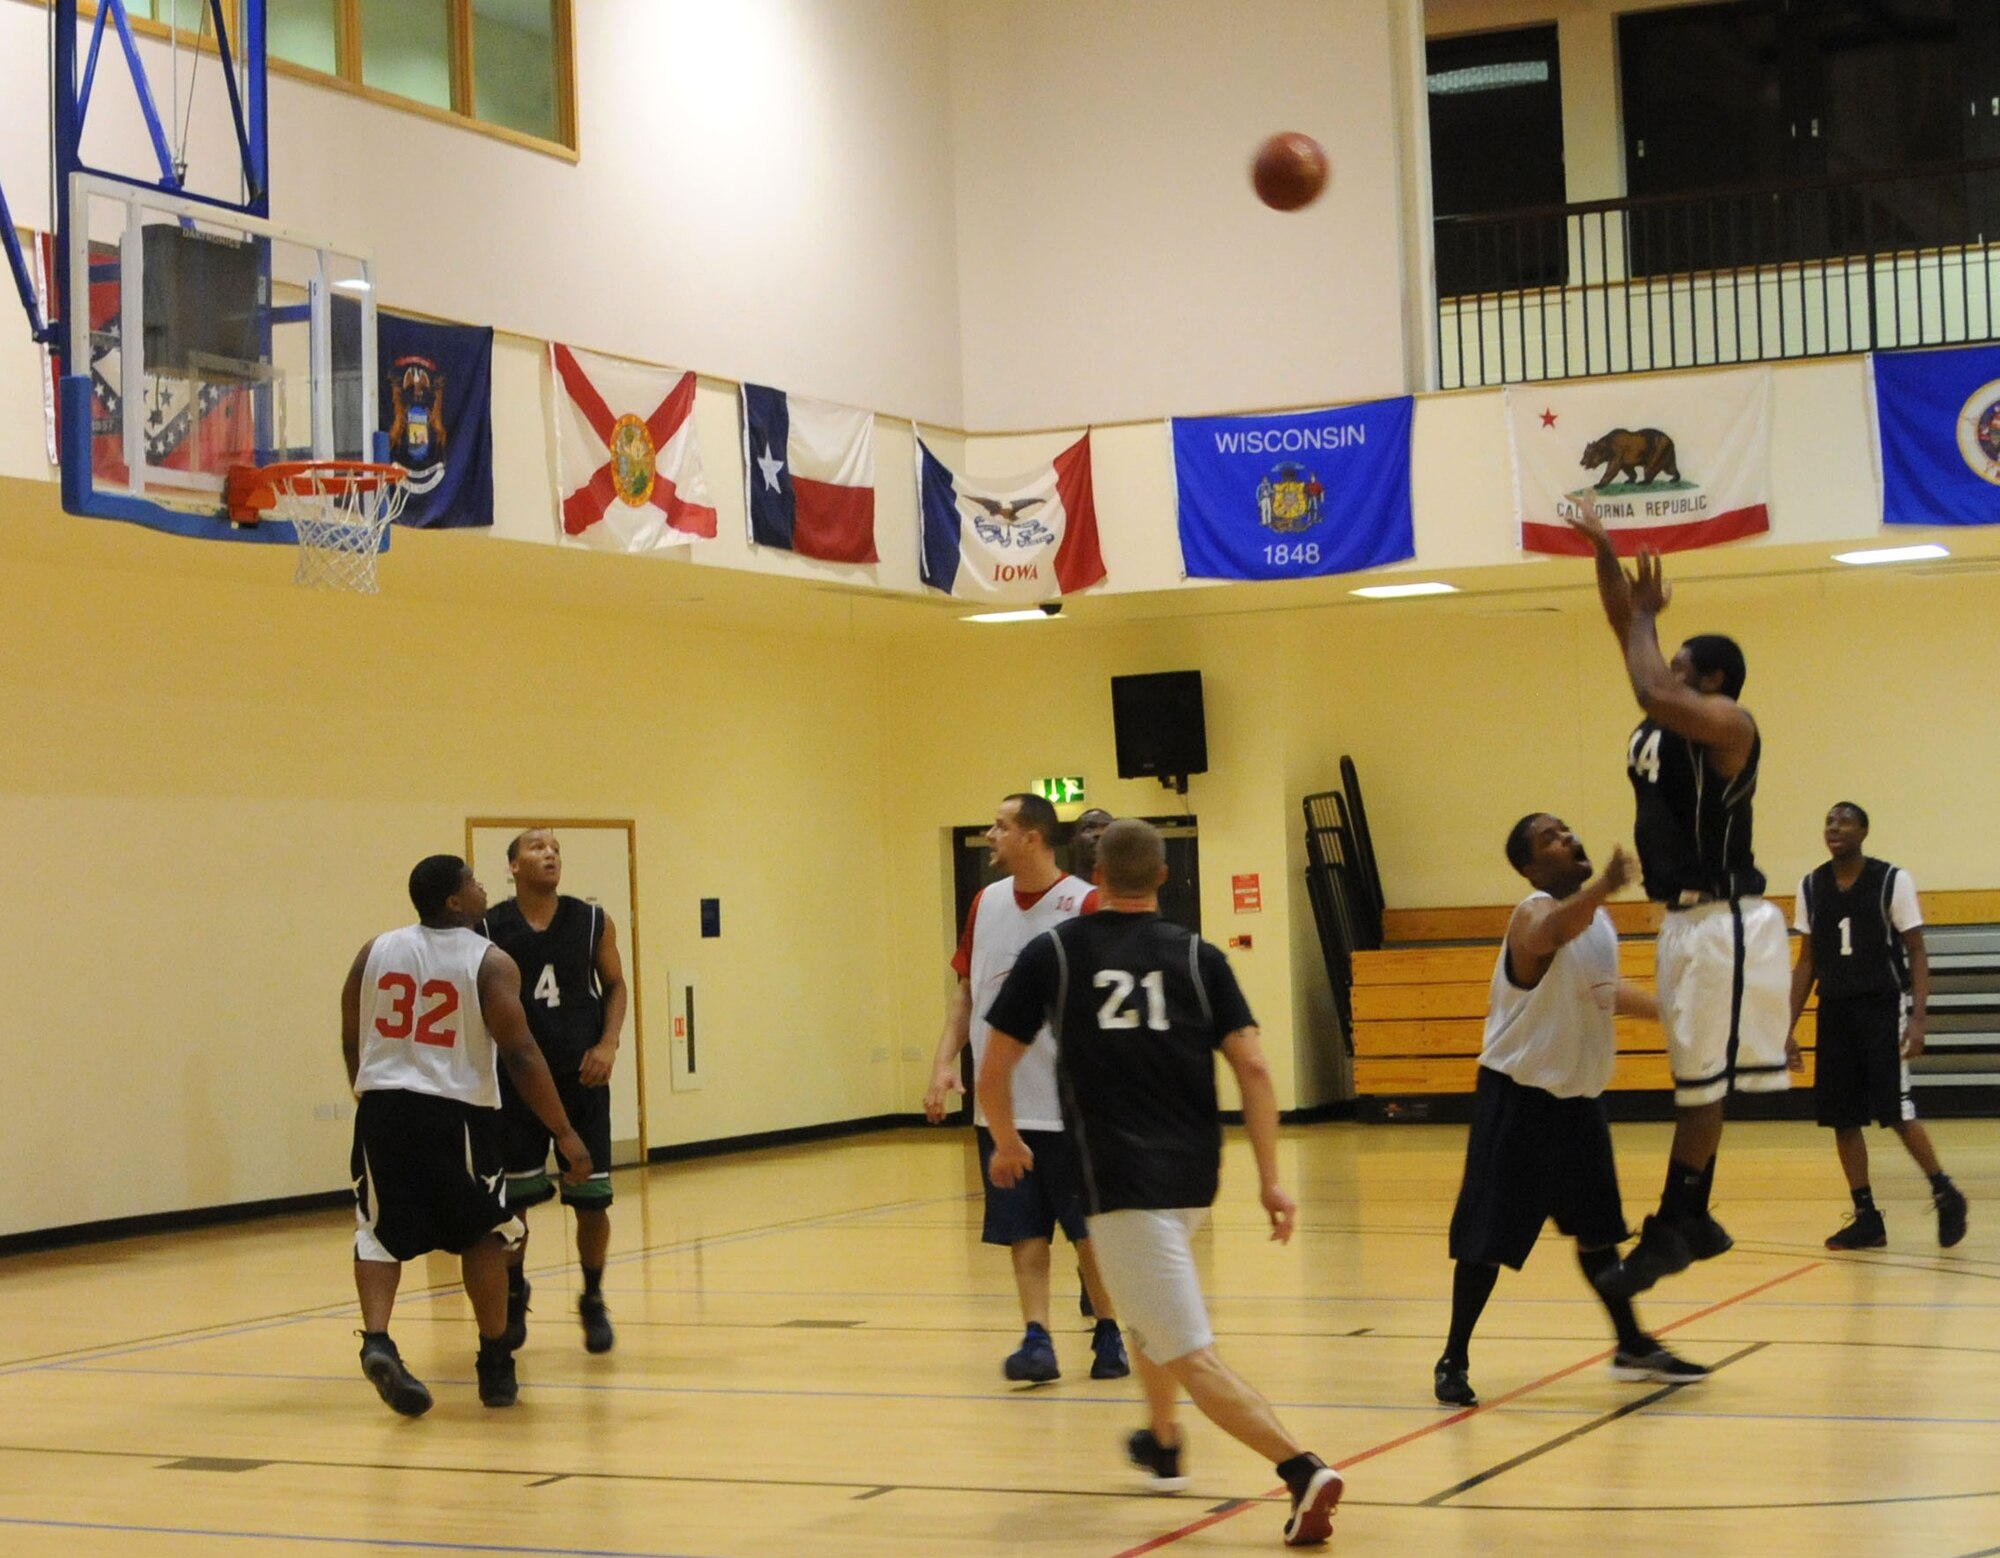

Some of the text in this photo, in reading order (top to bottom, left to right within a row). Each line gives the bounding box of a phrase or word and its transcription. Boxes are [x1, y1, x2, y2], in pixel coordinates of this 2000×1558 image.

[1214, 423, 1366, 454] WISCONSIN
[1556, 494, 1708, 519] CALORNIA REPUBLIC
[1263, 542, 1321, 566] 1848
[993, 563, 1039, 582] IOWA
[1837, 916, 1854, 956] 1
[533, 963, 561, 1009] 4
[1092, 968, 1171, 1032] 21
[374, 971, 460, 1049] 32
